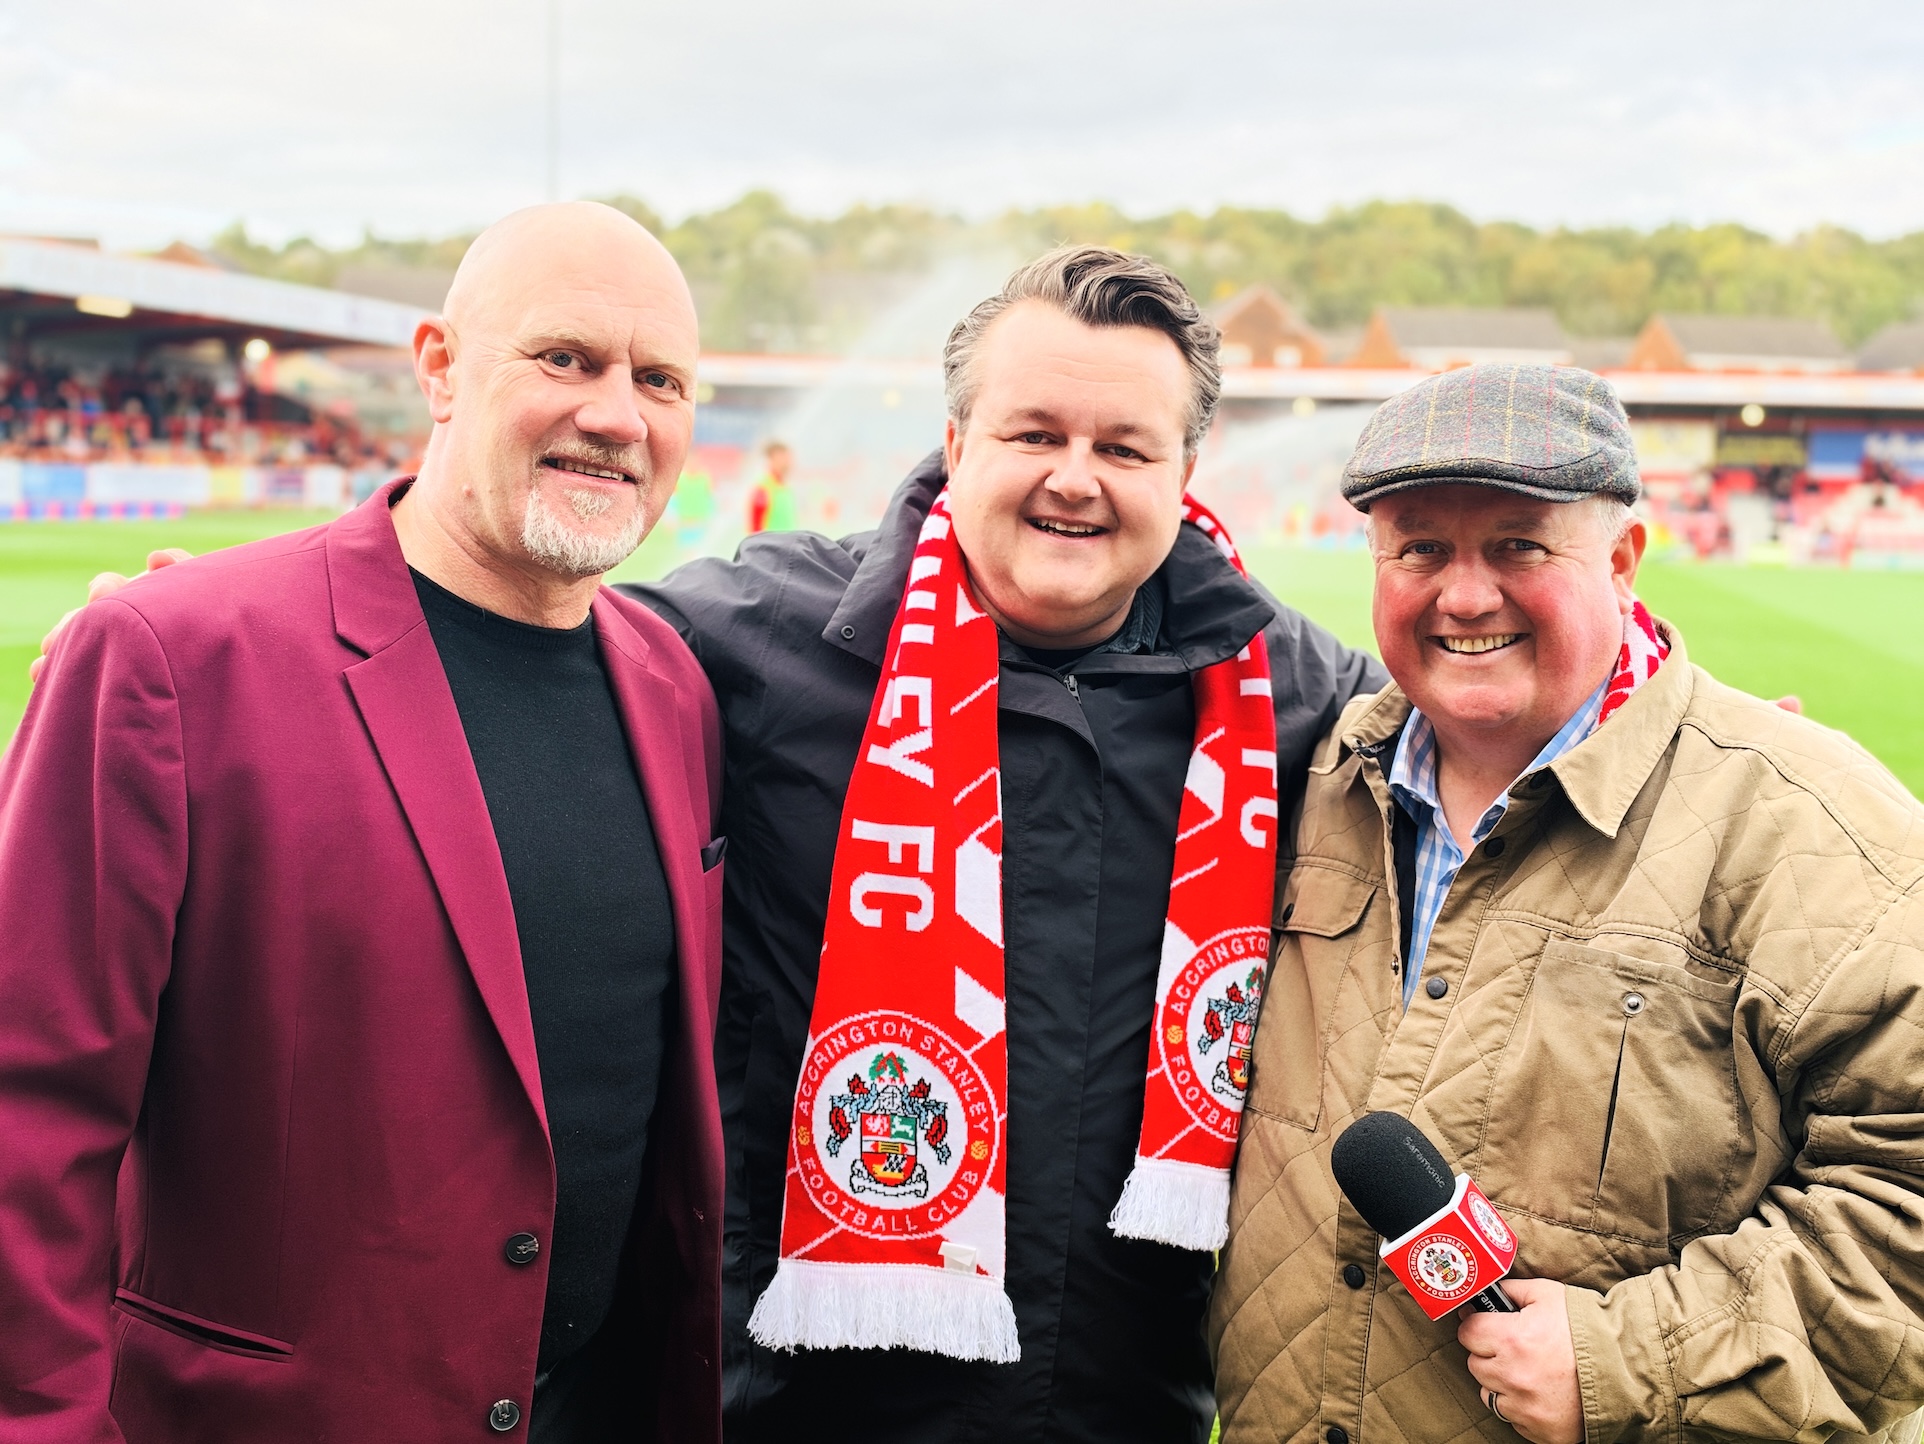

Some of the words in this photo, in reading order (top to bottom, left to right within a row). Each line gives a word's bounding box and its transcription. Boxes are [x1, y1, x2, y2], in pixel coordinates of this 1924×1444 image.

[849, 818, 935, 933] FC
[1170, 934, 1269, 1016] ACCRINGTO
[799, 1021, 913, 1115] ACCRINGTON
[919, 1035, 989, 1133] STANLEY
[1172, 1053, 1238, 1134] FOOTBAL
[803, 1157, 918, 1232] FOOTBALL
[928, 1170, 979, 1222] CLUB
[1410, 1237, 1431, 1280] ACCRINGTON
[1431, 1236, 1466, 1252] STANLEY
[1426, 1284, 1469, 1298] FOOTBALL
[1467, 1260, 1475, 1282] CLUB
